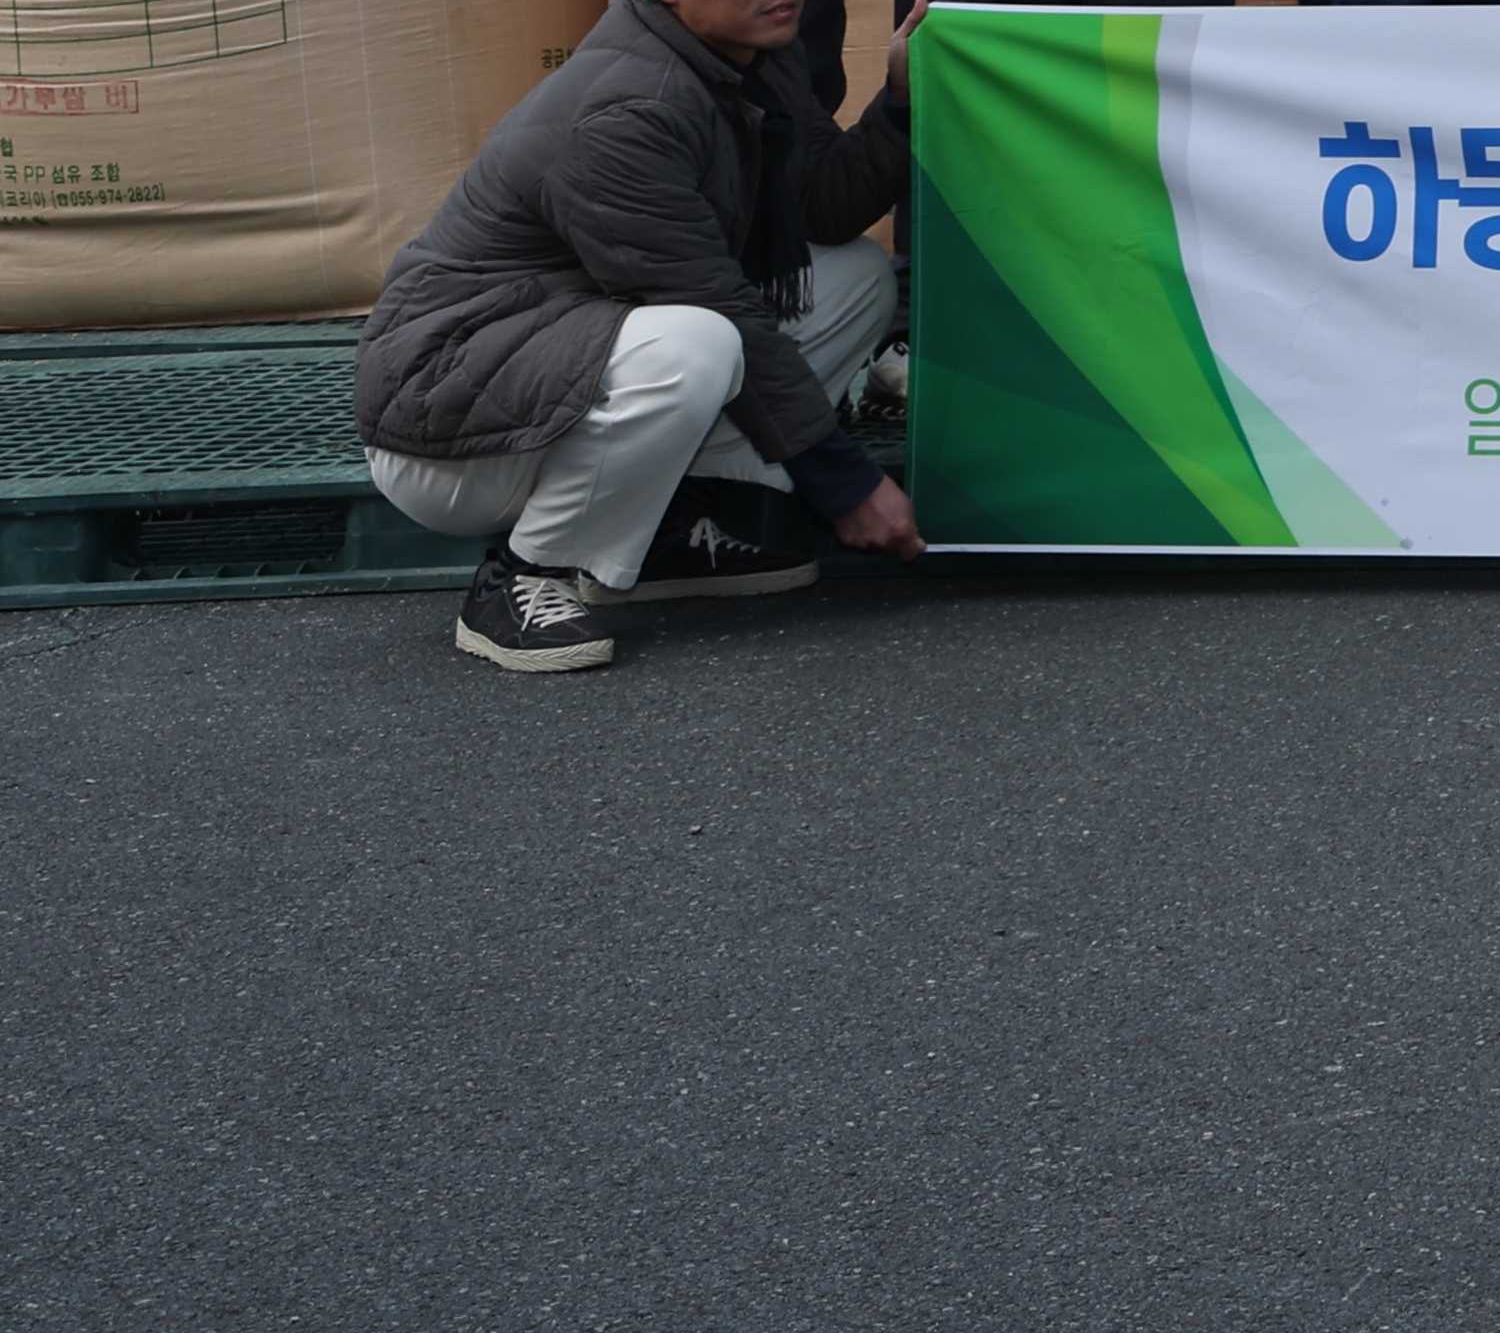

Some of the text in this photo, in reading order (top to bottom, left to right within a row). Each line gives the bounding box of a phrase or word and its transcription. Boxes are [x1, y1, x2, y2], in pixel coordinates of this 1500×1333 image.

[0, 162, 120, 184] 국 PP 섬유 조합
